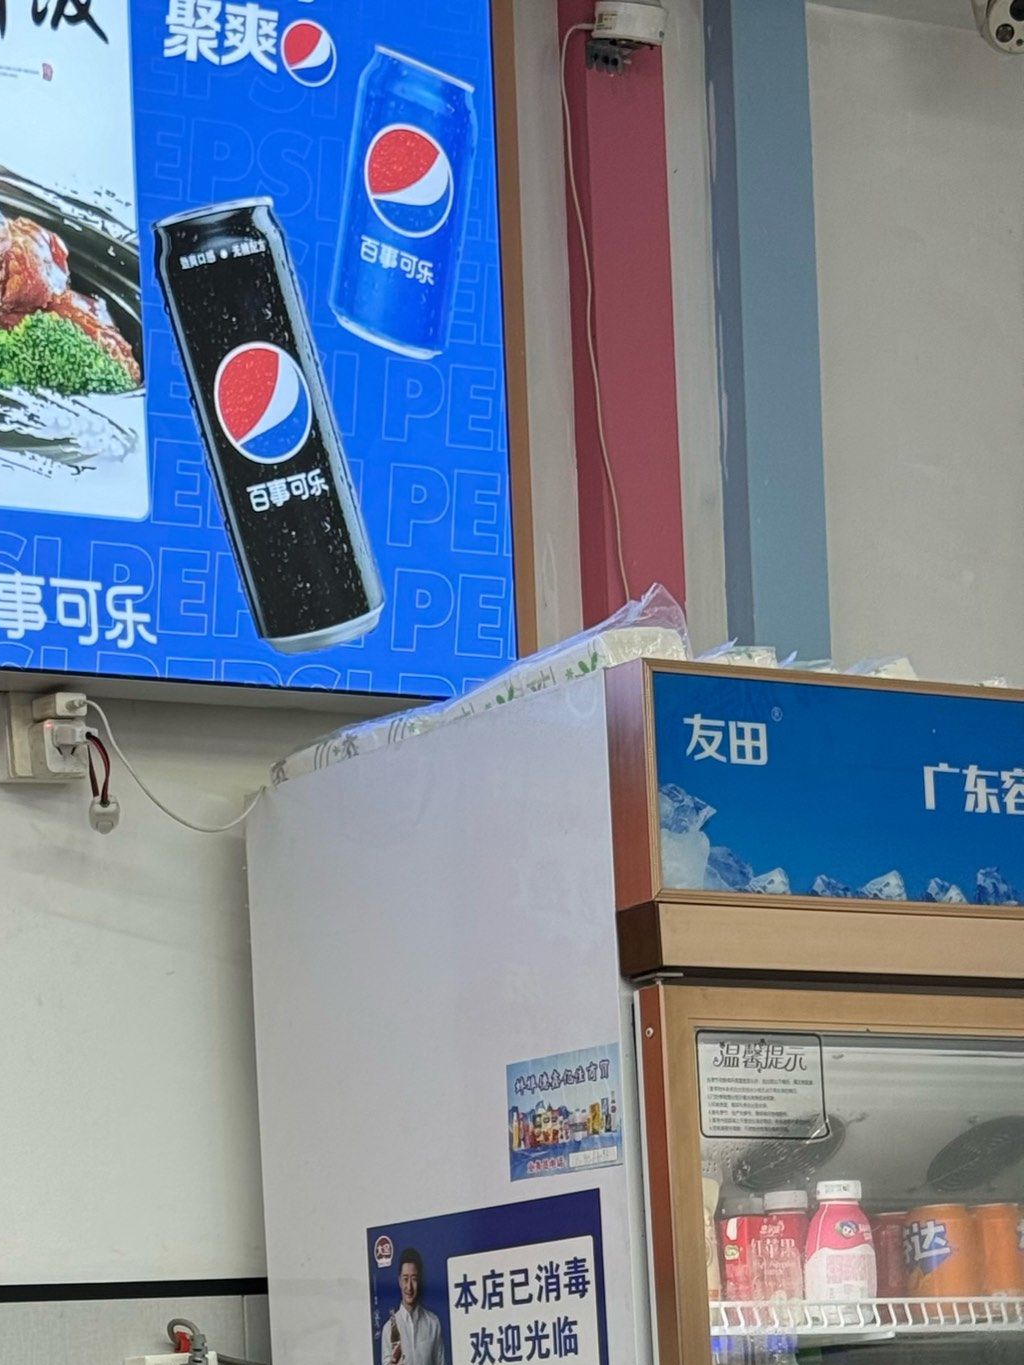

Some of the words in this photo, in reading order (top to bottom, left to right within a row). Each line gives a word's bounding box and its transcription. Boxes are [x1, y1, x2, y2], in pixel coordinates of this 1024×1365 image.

[163, 0, 278, 74] 聚爽
[360, 235, 436, 286] 百事可乐
[246, 468, 330, 513] 百事可乐
[683, 713, 769, 766] 友田
[713, 1038, 807, 1073] 温馨提示
[454, 1256, 591, 1314] 本店已消毒
